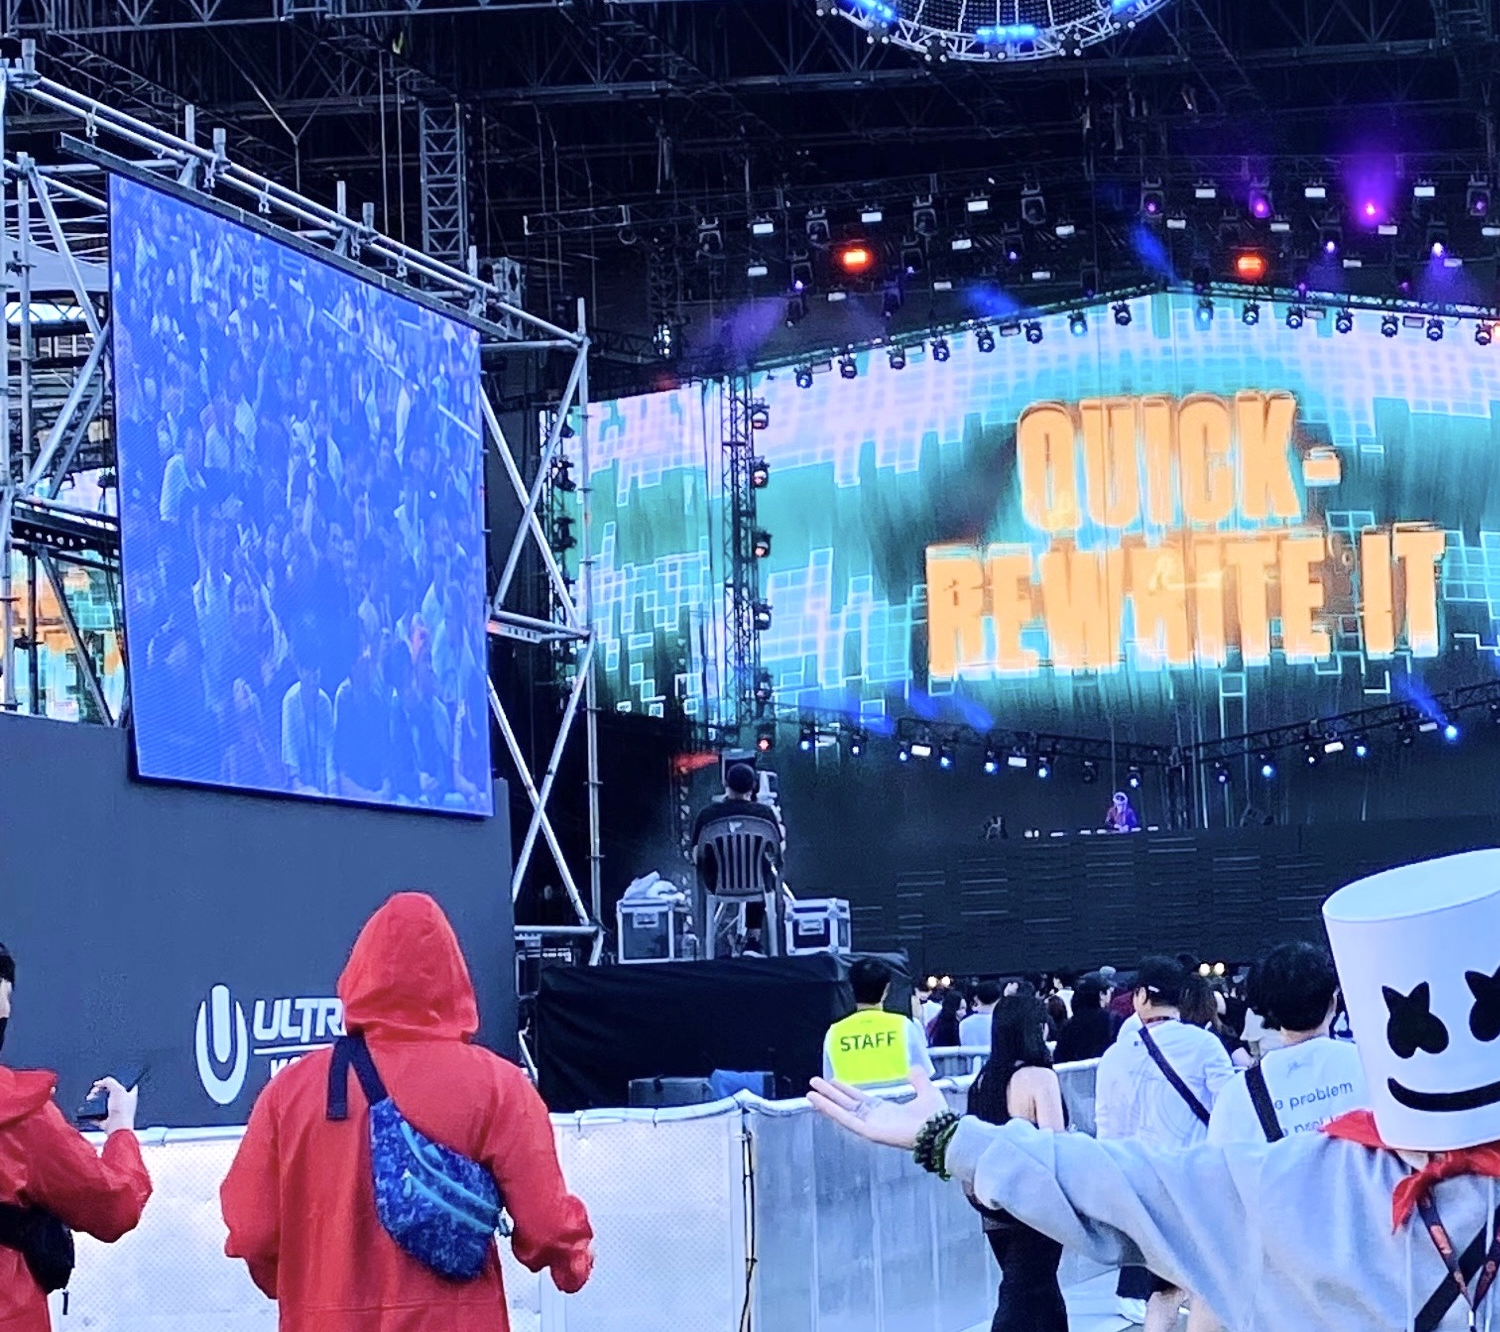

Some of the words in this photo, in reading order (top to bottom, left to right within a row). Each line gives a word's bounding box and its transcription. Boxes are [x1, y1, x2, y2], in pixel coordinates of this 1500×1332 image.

[1016, 389, 1342, 532] QUICK-
[925, 529, 1331, 680] REWRITE
[1360, 521, 1446, 659] IT
[840, 1031, 897, 1052] STAFF
[1289, 1081, 1354, 1110] problem
